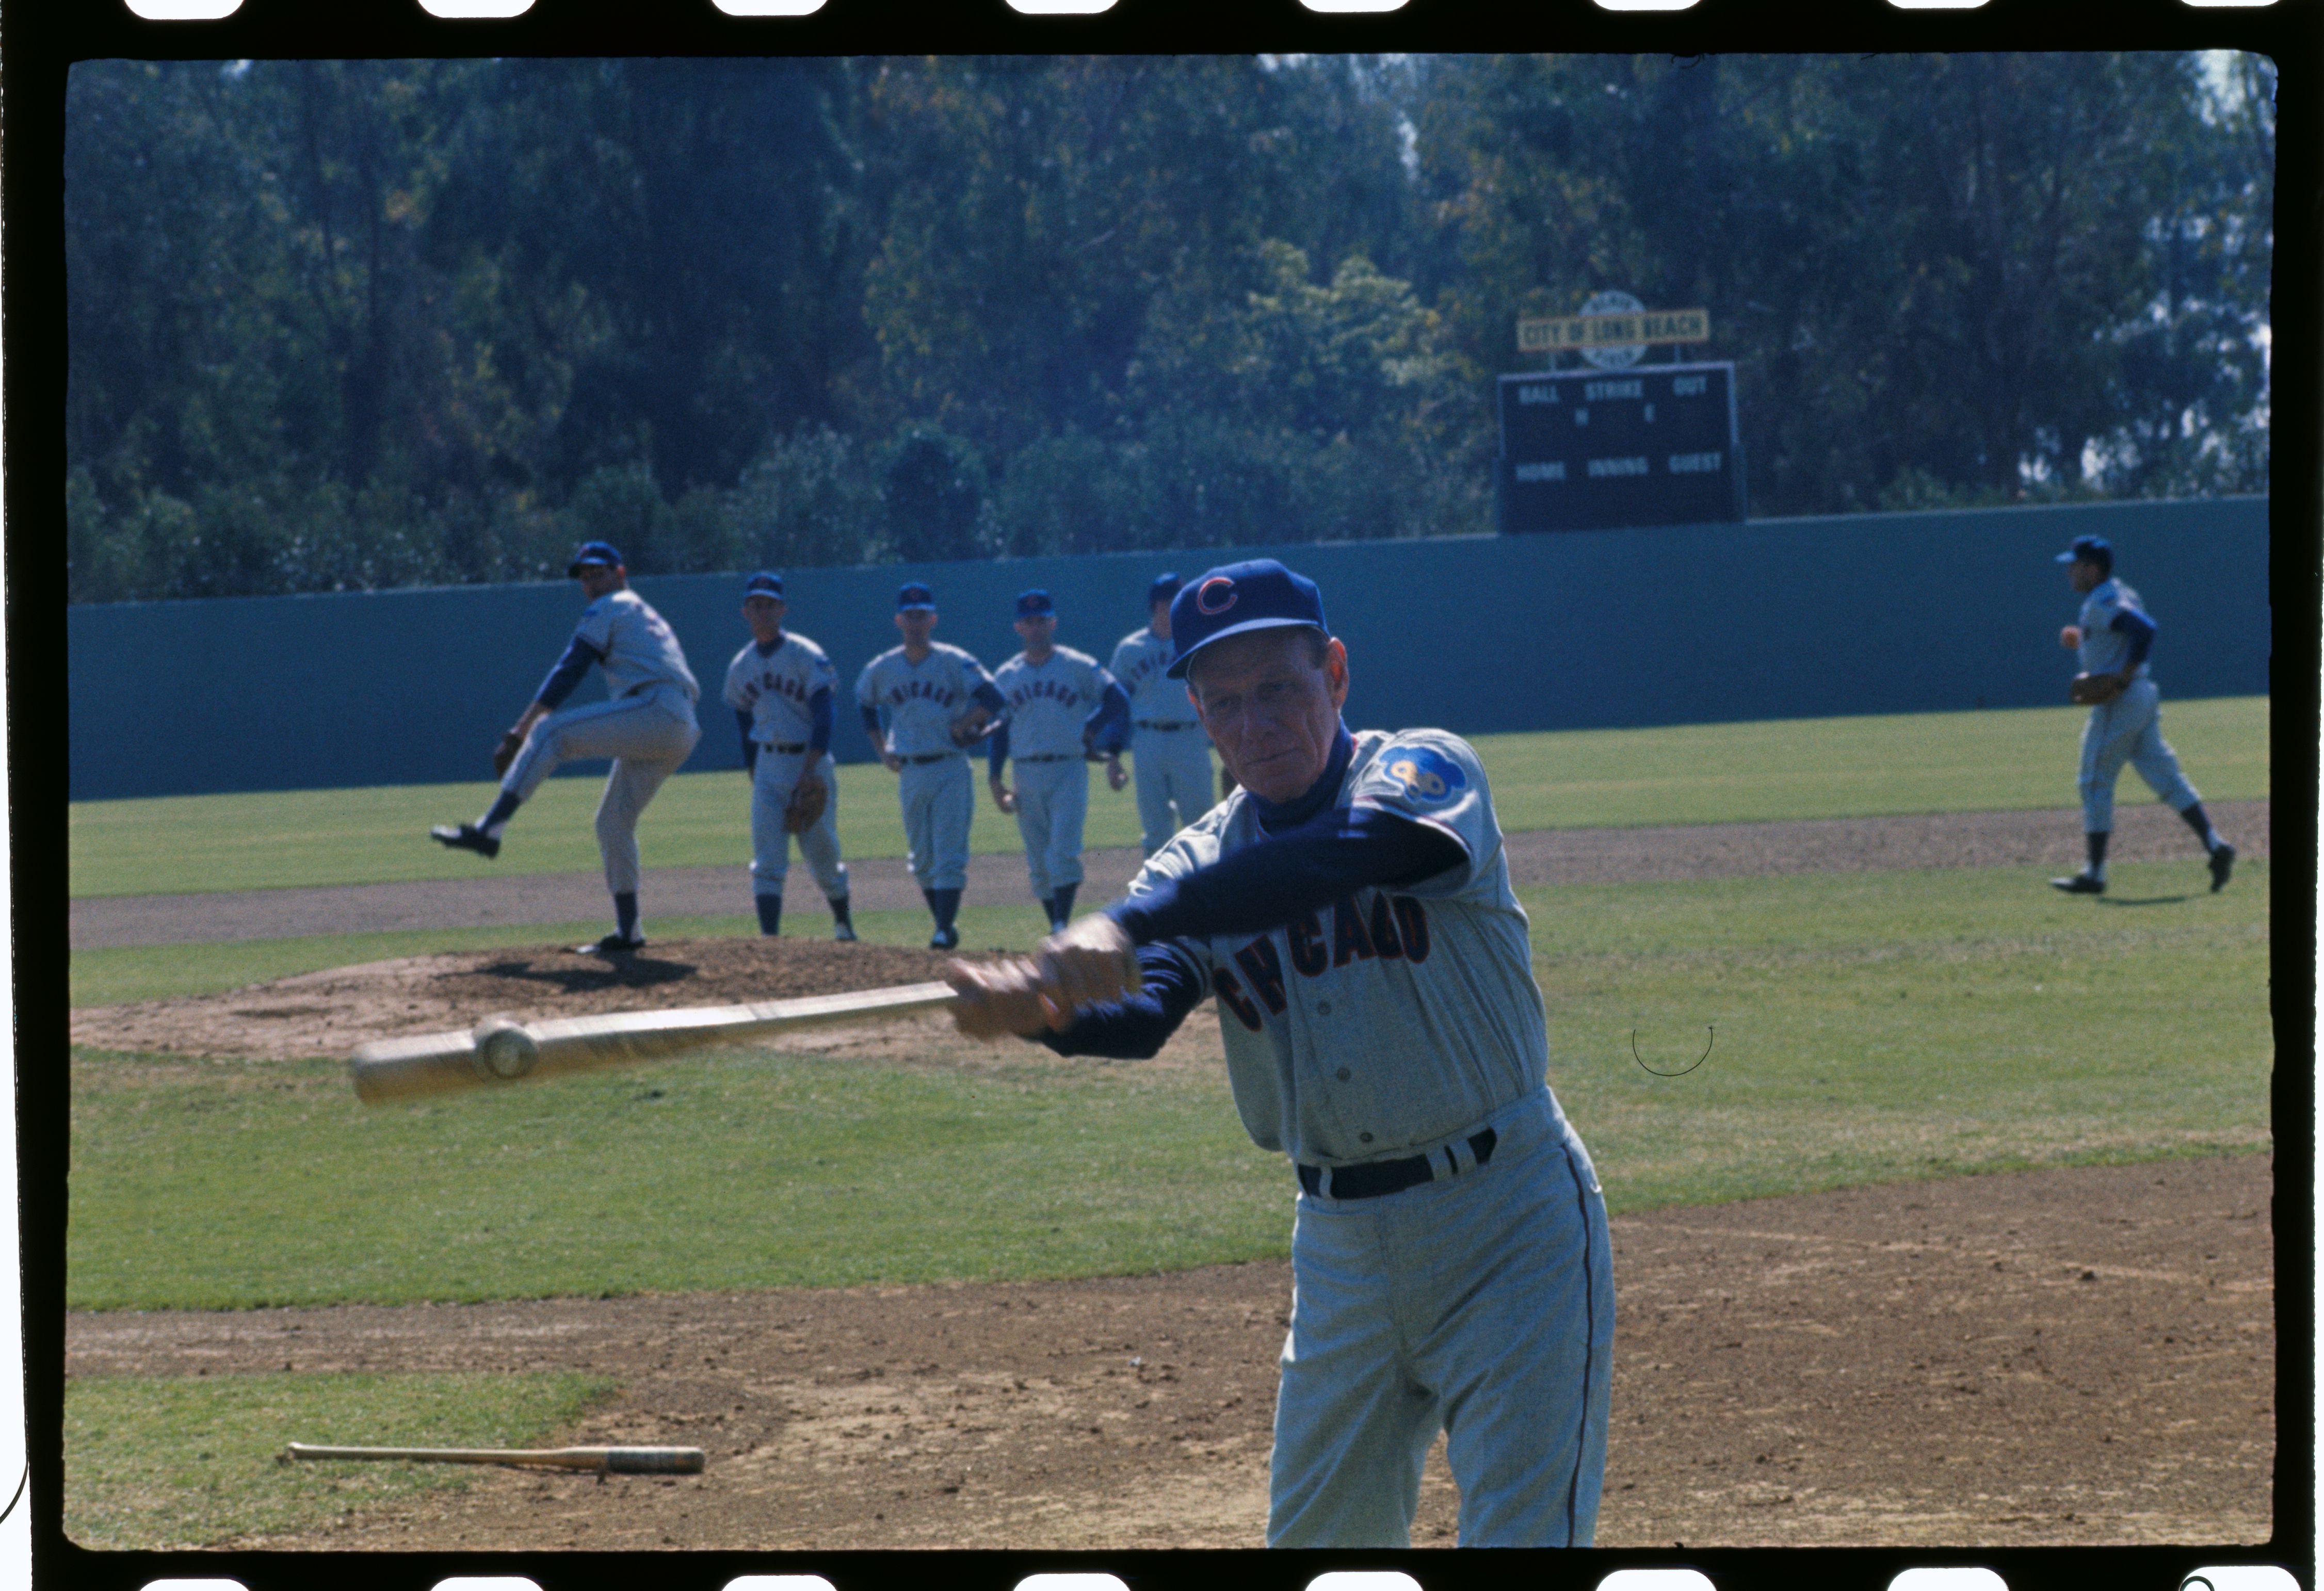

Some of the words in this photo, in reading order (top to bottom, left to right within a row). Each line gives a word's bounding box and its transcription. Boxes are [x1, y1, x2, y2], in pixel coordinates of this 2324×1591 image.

[1524, 323, 1560, 345] CITY
[1568, 321, 1584, 342] OF
[1593, 318, 1636, 341] LONG
[1643, 315, 1702, 338] BEACH
[1519, 385, 1560, 404] BALL
[1585, 379, 1643, 401] STRIKE
[1673, 376, 1706, 396] OUT
[1515, 461, 1565, 482] HOME
[1588, 457, 1648, 478] INNING
[1669, 451, 1720, 474] GUEST
[1197, 577, 1237, 614] C
[1212, 890, 1430, 1032] CHCAGO
